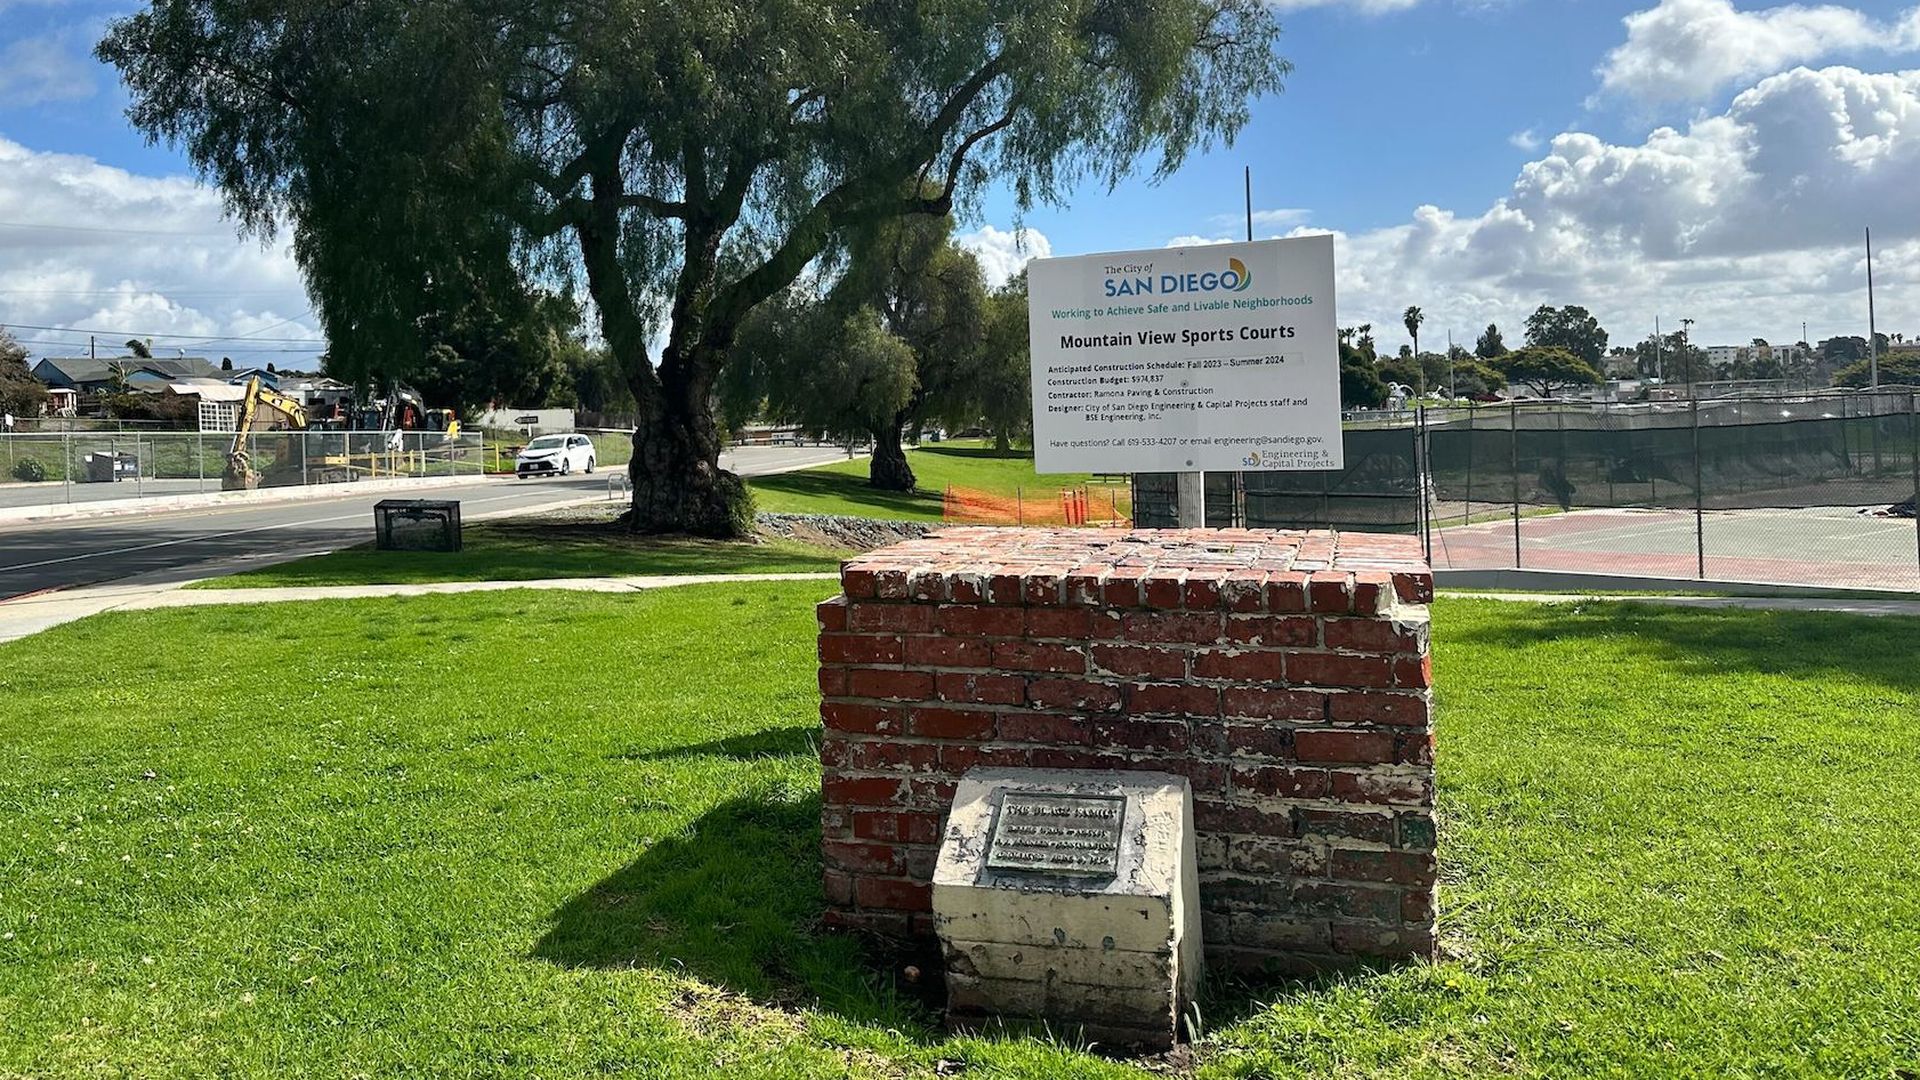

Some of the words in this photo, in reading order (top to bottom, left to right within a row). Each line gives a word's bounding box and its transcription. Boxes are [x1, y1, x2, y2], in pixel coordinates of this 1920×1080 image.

[1104, 266, 1121, 274] The
[1123, 263, 1142, 273] City
[1144, 263, 1153, 272] of
[1105, 277, 1153, 297] SAN
[1161, 271, 1239, 293] DIEGO
[1052, 308, 1091, 319] Working
[1094, 308, 1103, 316] to
[1107, 305, 1144, 316] Achieve
[1147, 303, 1168, 314] Safe
[1172, 302, 1190, 312] and
[1194, 299, 1229, 311] Livable
[1233, 295, 1313, 310] Neighborhoods
[1061, 332, 1132, 348] Mountain
[1137, 330, 1176, 345] View
[1182, 328, 1233, 346] Sports
[1240, 325, 1295, 340] Courts
[1048, 365, 1091, 374] Anticipated
[1094, 363, 1144, 371] Construction
[1147, 361, 1184, 370] Schedule:
[1187, 360, 1201, 369] Fall
[1203, 359, 1222, 368] 2023
[1230, 358, 1263, 367] Summer
[1266, 355, 1284, 364] 2024
[1047, 378, 1097, 386] Construction
[1100, 376, 1129, 385] Budget:
[1131, 374, 1164, 384] $974,837
[1048, 391, 1092, 399] Contractor:
[1094, 390, 1124, 398] Ramona
[1127, 388, 1152, 398] Paving
[1154, 388, 1160, 396] &
[1162, 386, 1214, 396] Construction
[1048, 404, 1084, 413] Designer:
[1085, 404, 1100, 413] City
[1102, 403, 1110, 411] of
[1112, 403, 1126, 411] San
[1128, 402, 1149, 411] Diego
[1151, 401, 1195, 411] Engineering
[1197, 401, 1204, 409] &
[1206, 400, 1233, 410] Capital
[1235, 398, 1268, 409] Projects
[1270, 398, 1290, 407] staff
[1293, 398, 1308, 406] and
[1085, 413, 1098, 421] BSE
[1101, 412, 1146, 422] Engineering,
[1148, 412, 1162, 420] Inc.
[1050, 440, 1068, 448] Have
[1070, 438, 1110, 448] questions?
[1112, 438, 1125, 446] Call
[1127, 437, 1177, 446] 619-533-4207
[1190, 437, 1212, 445] email
[1262, 450, 1319, 461] Engineering
[1262, 460, 1294, 469] Capital
[1297, 458, 1335, 469] Projects
